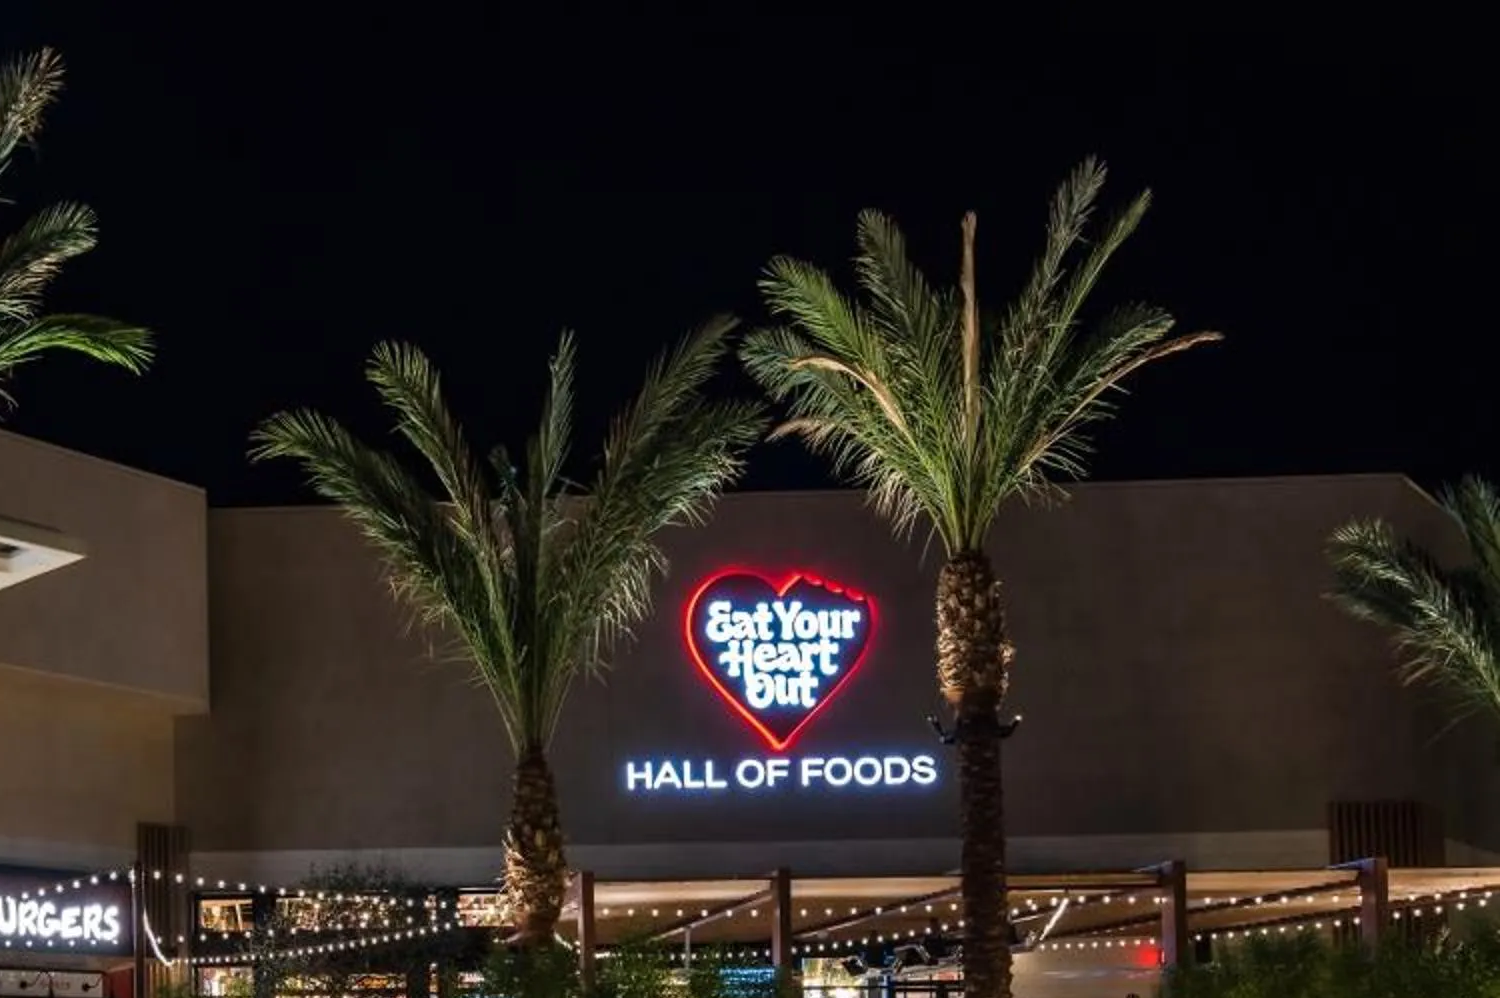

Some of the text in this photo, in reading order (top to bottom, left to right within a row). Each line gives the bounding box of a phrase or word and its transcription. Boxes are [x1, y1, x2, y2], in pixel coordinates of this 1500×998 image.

[705, 600, 861, 642] Eat Your
[719, 639, 839, 677] Heart
[745, 672, 818, 709] Out
[626, 755, 937, 791] HALL OF FOODS
